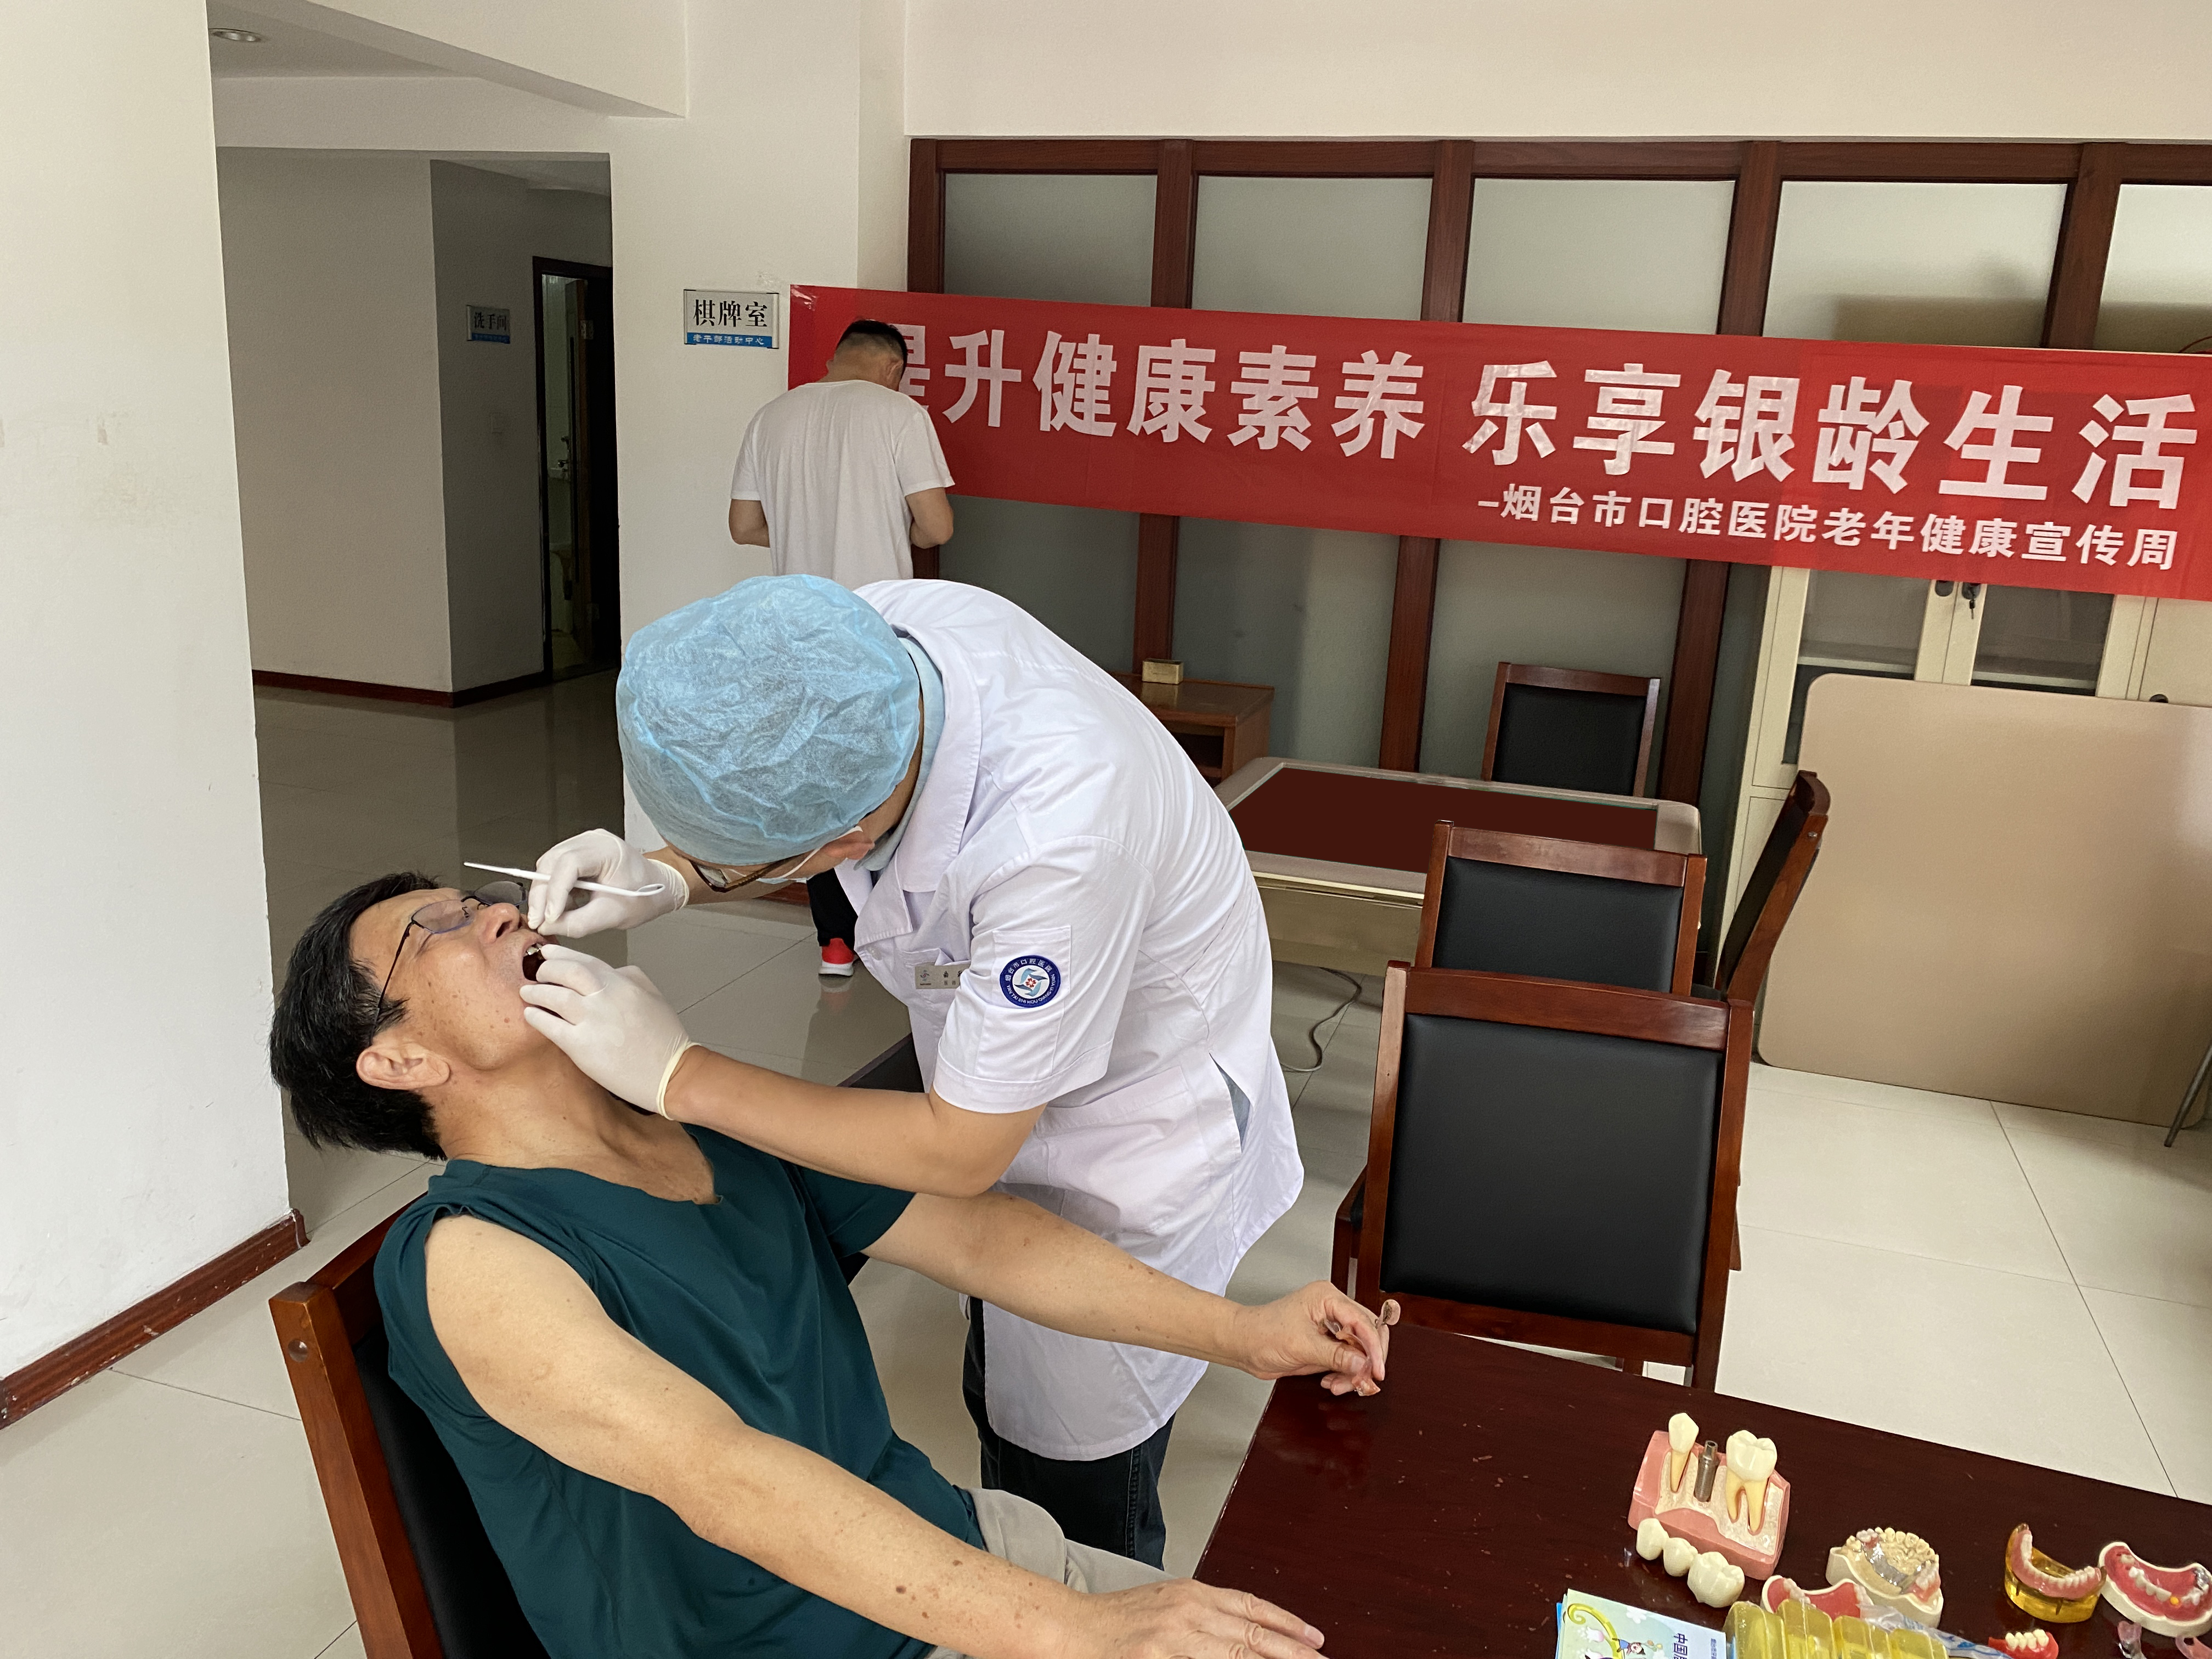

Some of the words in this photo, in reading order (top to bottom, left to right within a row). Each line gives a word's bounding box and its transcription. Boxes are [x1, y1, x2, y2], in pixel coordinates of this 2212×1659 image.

[474, 312, 507, 330] 洗手间
[693, 299, 768, 328] 棋牌室
[693, 334, 764, 345] 老干部活动中心
[1462, 360, 2198, 510] 乐享银龄生活
[1005, 958, 1053, 981] 烟台市口腔医院
